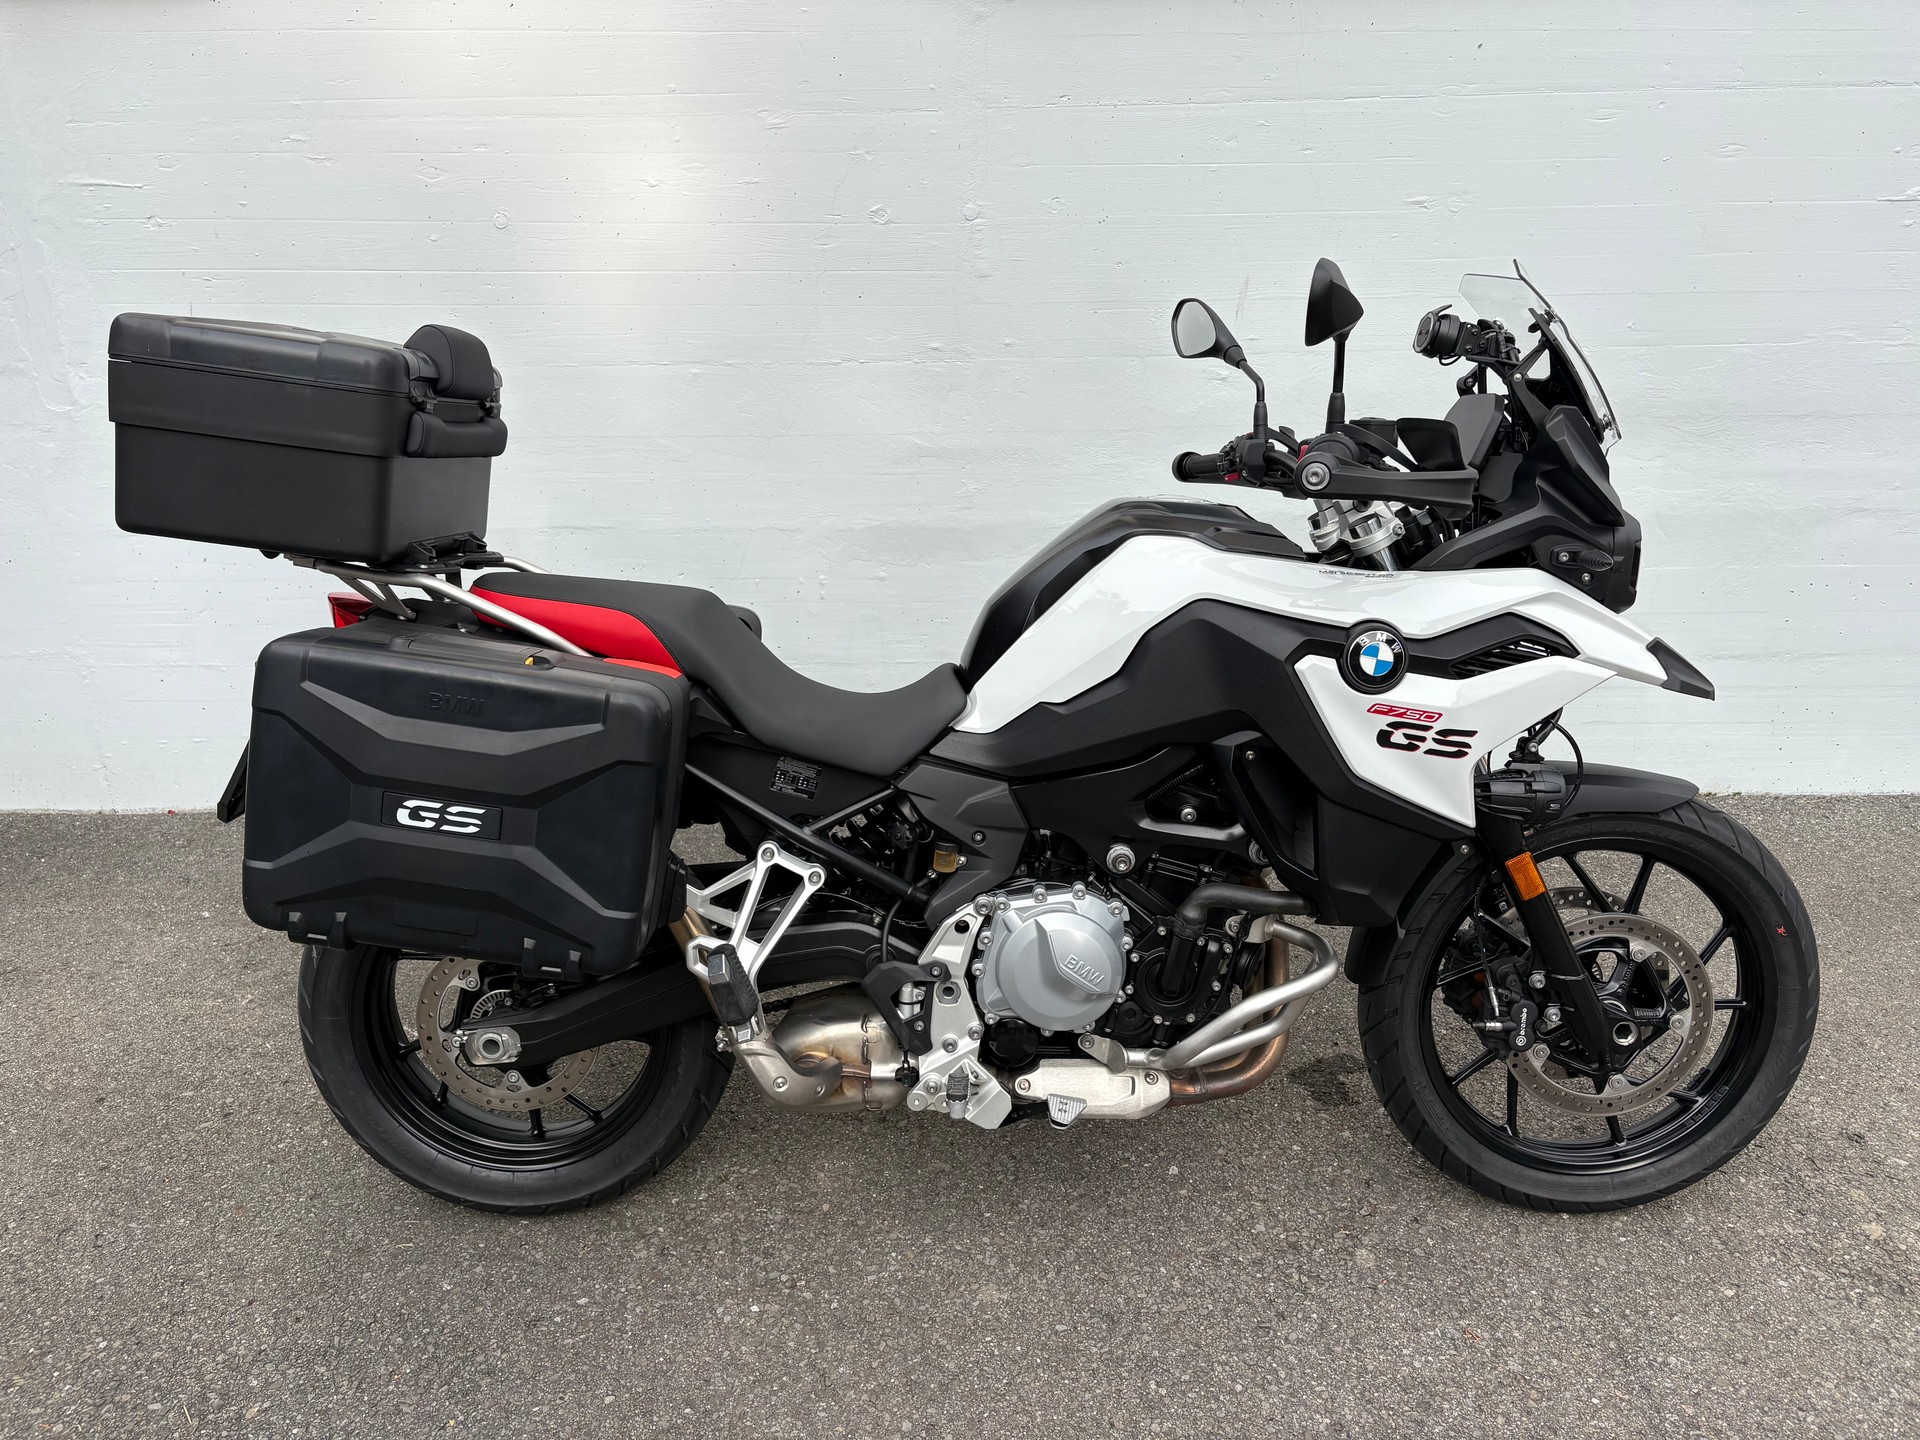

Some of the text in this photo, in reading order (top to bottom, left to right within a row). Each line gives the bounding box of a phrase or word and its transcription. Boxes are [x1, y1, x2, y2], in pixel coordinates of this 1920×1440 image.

[1360, 632, 1402, 653] BMW
[429, 691, 486, 716] BMW
[1369, 704, 1440, 722] F750
[1376, 721, 1478, 759] GS
[397, 799, 487, 834] GS
[1064, 953, 1105, 985] BMW
[1519, 1008, 1528, 1036] brembo
